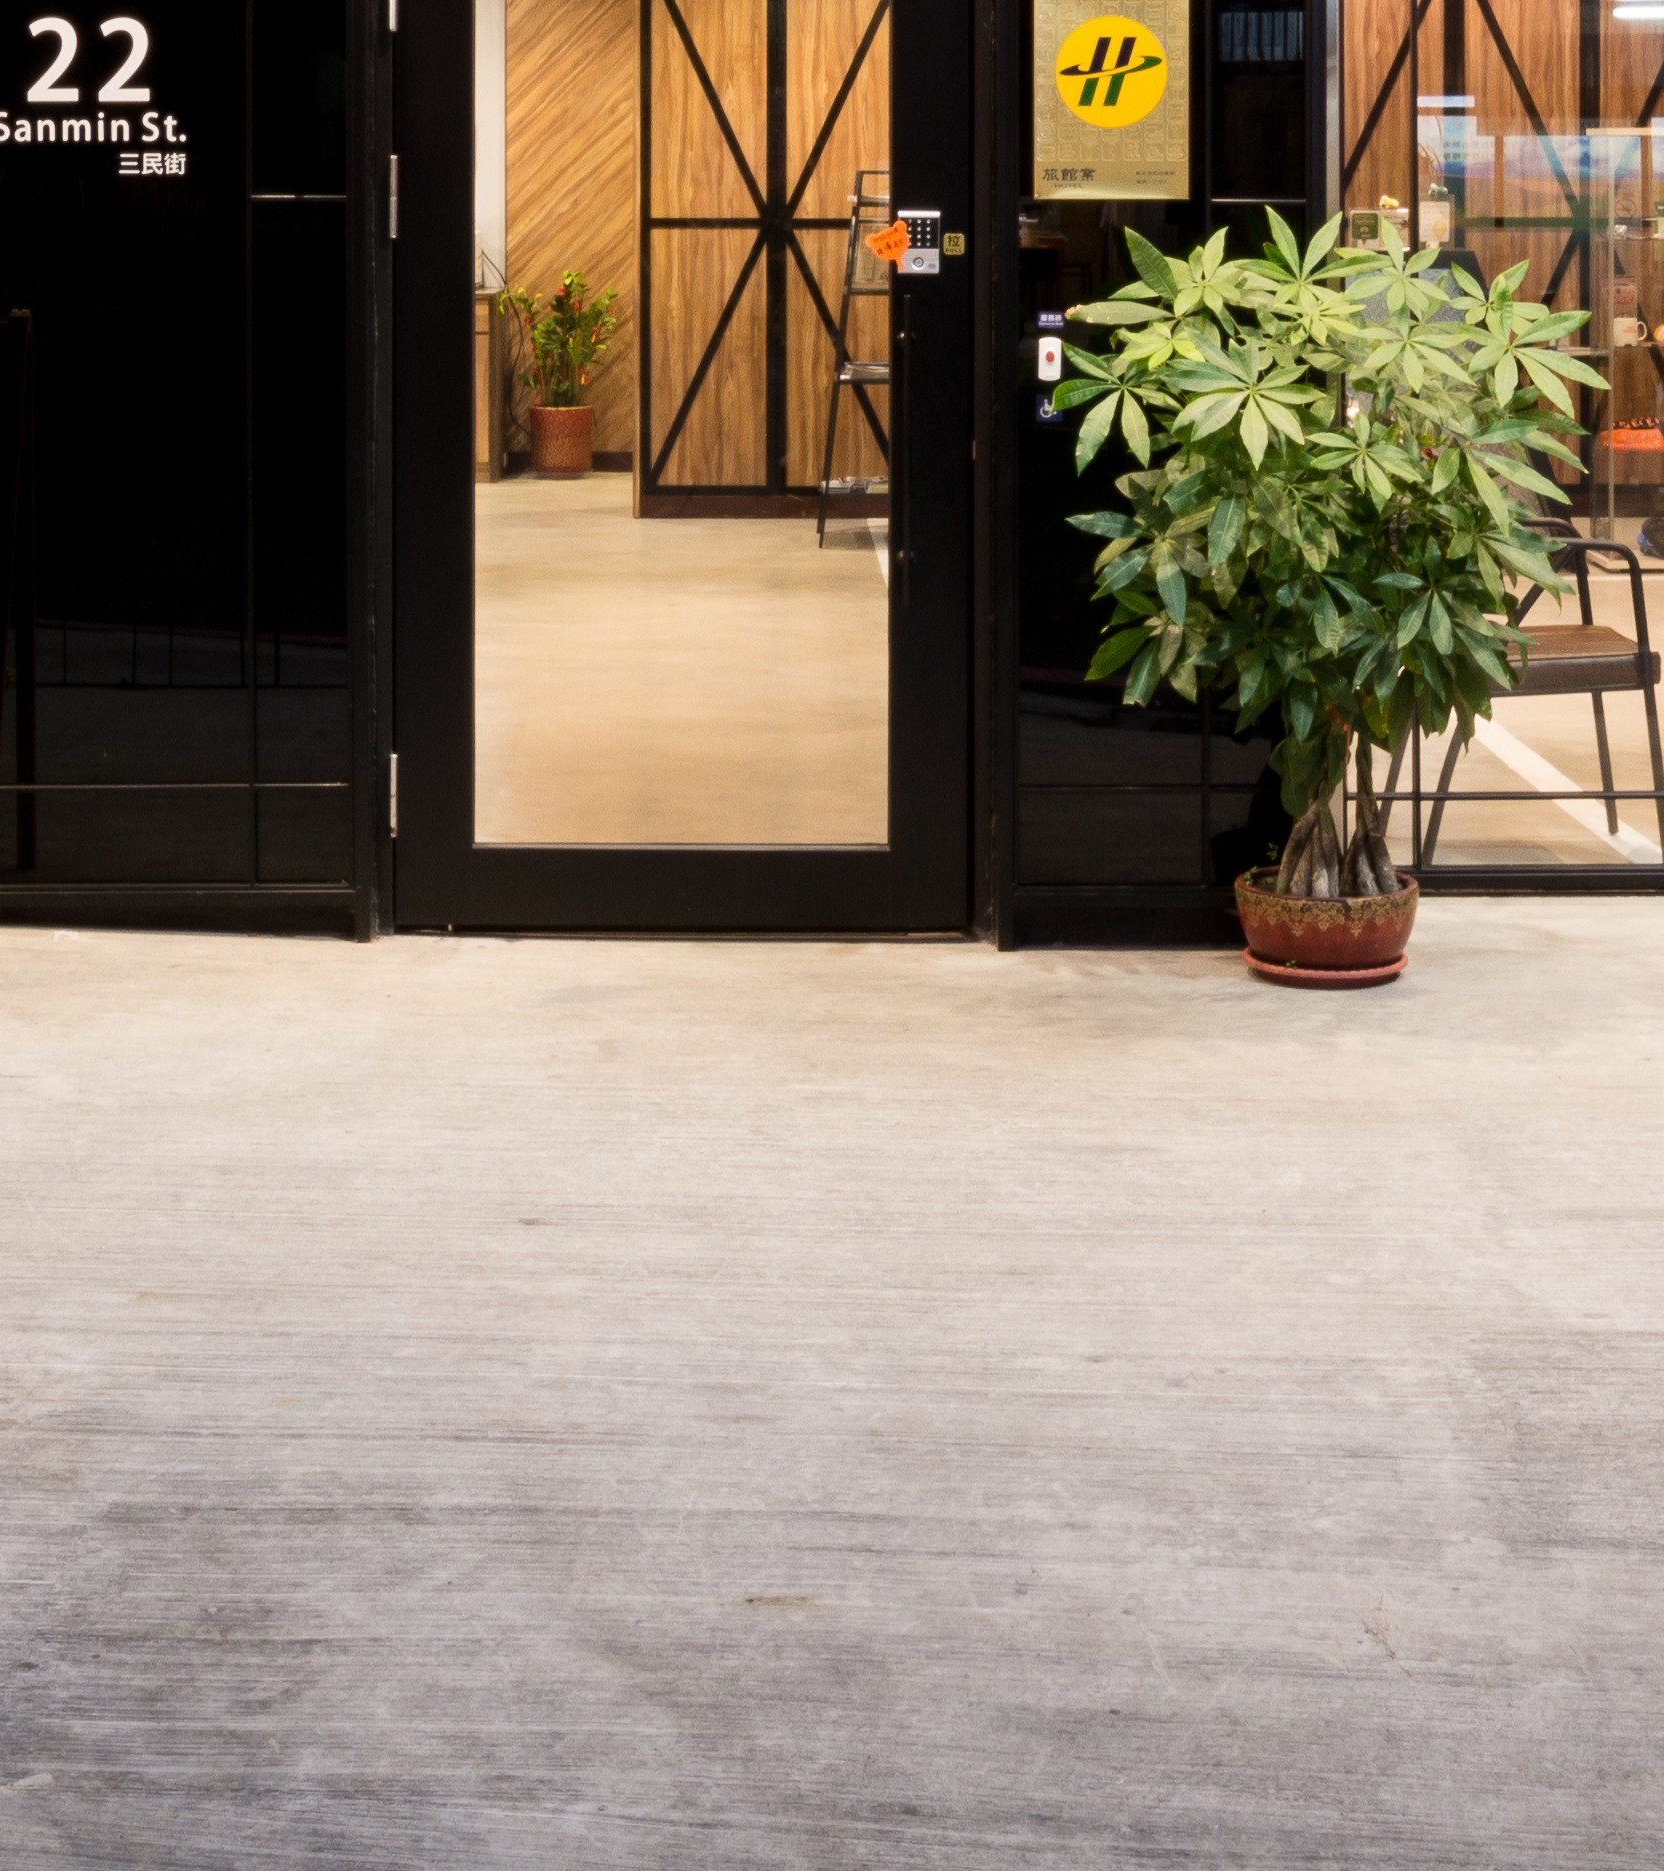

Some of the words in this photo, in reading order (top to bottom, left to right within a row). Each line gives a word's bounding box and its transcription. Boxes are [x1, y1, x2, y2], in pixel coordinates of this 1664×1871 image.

[27, 16, 151, 102] 22
[141, 111, 187, 143] St.
[118, 153, 186, 175] 三民街
[1042, 167, 1096, 182] 旅館業
